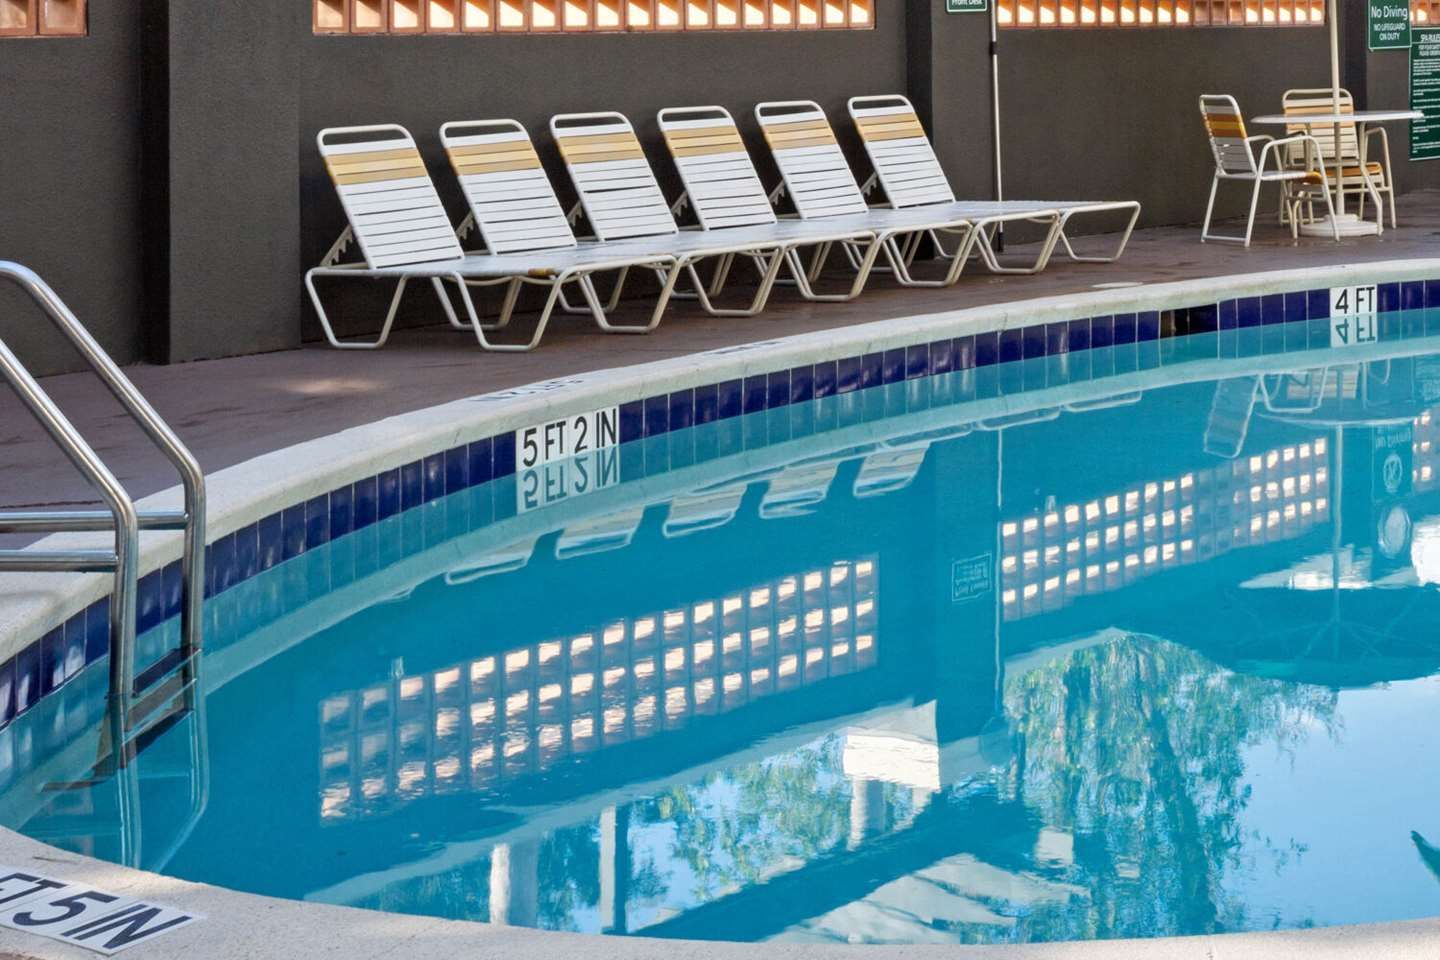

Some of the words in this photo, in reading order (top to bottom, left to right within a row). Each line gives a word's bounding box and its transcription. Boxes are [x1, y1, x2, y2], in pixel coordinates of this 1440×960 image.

[1371, 5, 1382, 18] No
[1383, 5, 1408, 20] Diving
[1373, 23, 1381, 31] NO
[1381, 22, 1406, 31] LIFEGUARD
[1379, 32, 1387, 40] ON
[1387, 32, 1400, 40] DUTY
[1335, 288, 1349, 314] 4
[1356, 286, 1375, 313] FT
[522, 427, 538, 467] 5
[545, 420, 567, 460] FT
[574, 416, 588, 454] 2
[596, 408, 617, 449] IN
[12, 890, 120, 926] 5
[61, 904, 193, 950] IN
